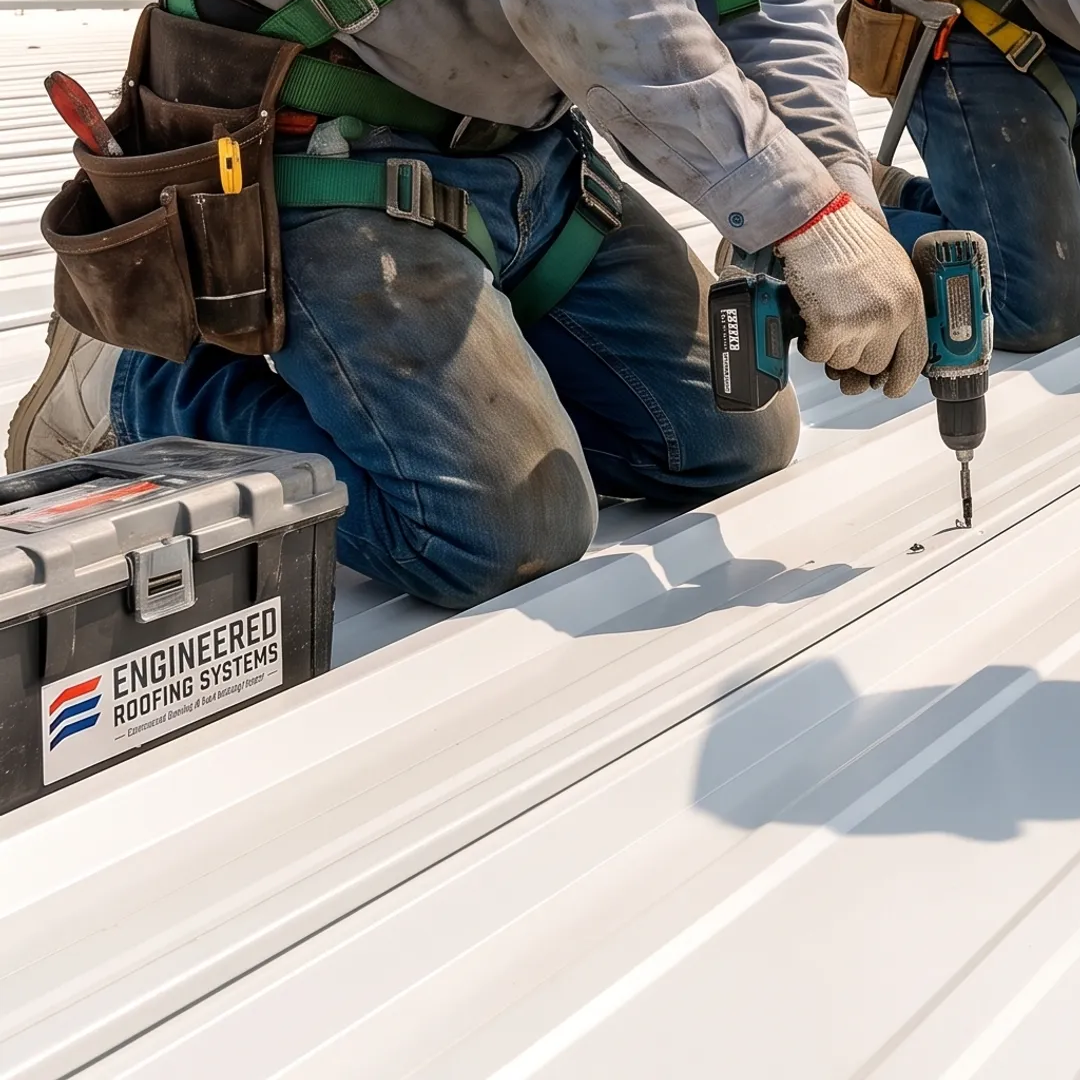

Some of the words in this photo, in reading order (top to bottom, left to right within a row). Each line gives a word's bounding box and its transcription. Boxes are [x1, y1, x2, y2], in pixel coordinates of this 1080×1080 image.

[113, 607, 277, 700] ENGINEERED
[114, 676, 193, 727] ROOFING
[200, 642, 278, 690] SYSTEMS
